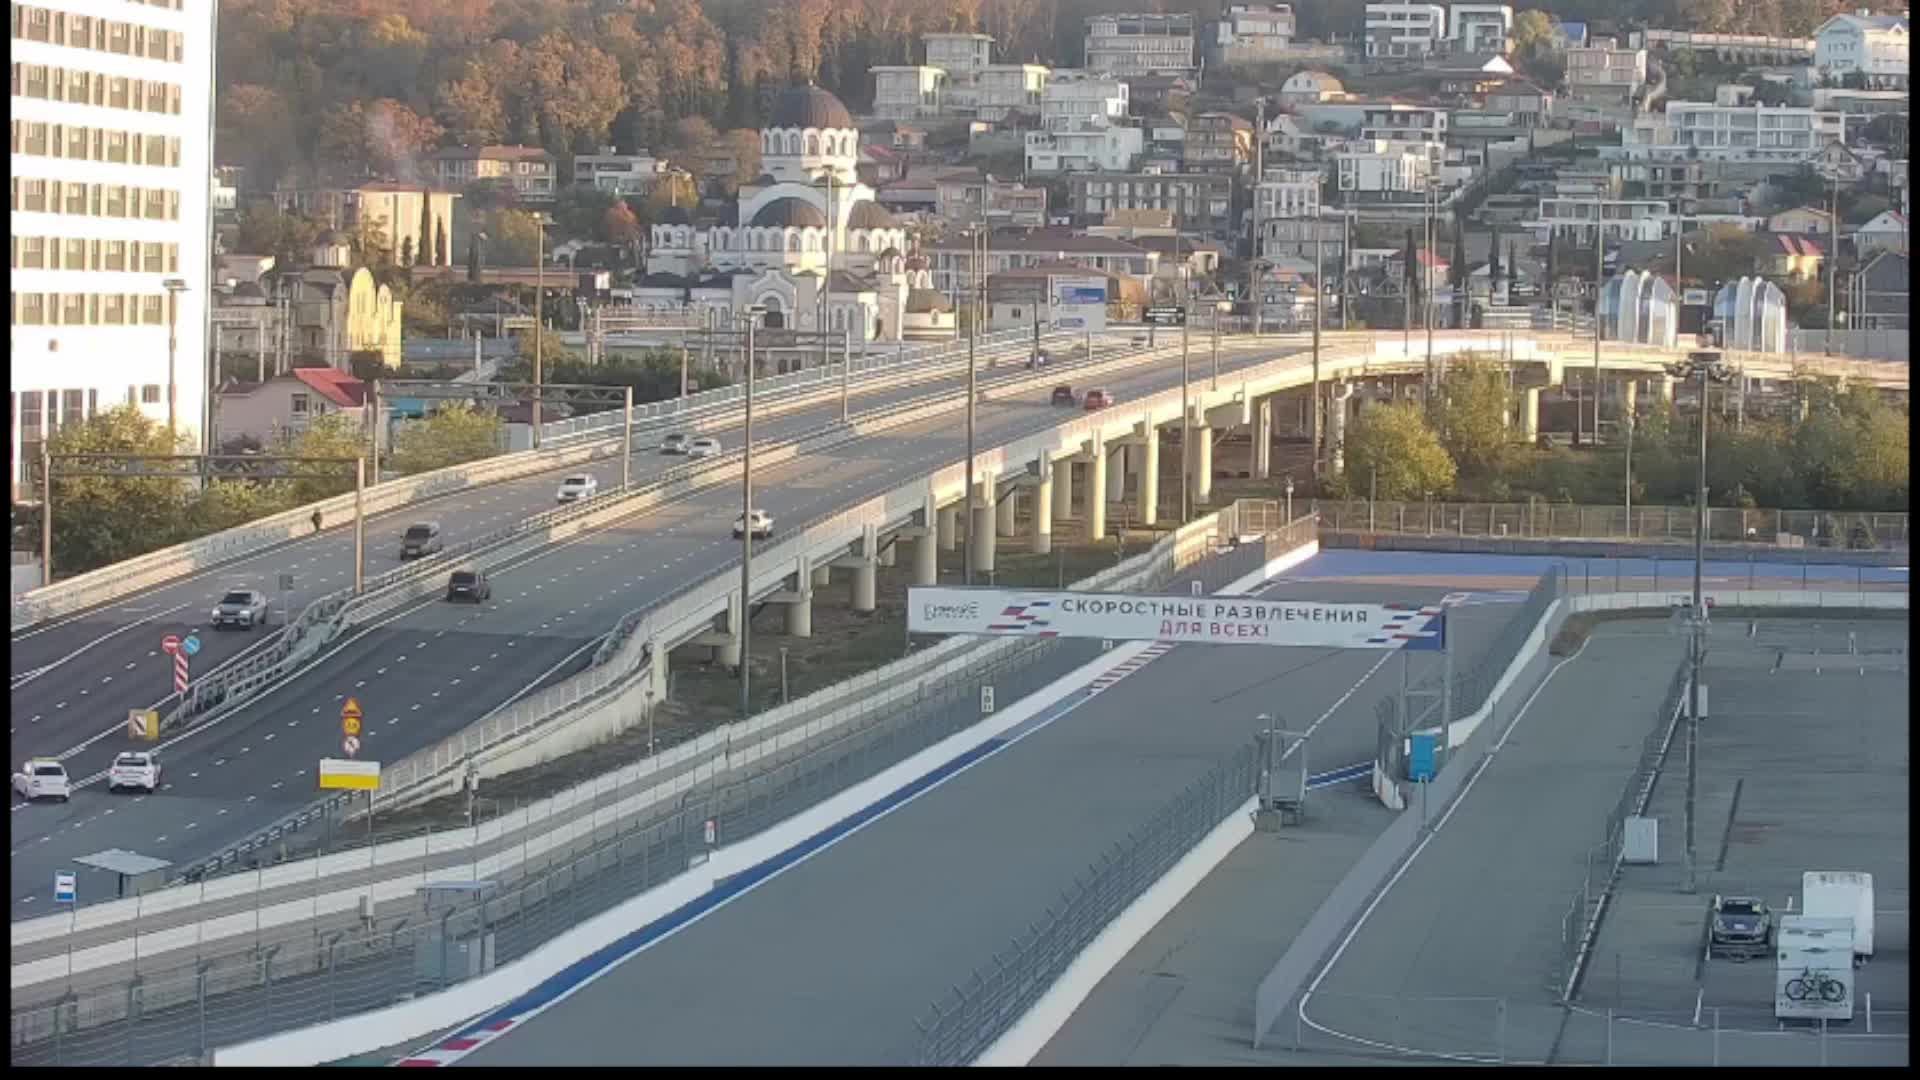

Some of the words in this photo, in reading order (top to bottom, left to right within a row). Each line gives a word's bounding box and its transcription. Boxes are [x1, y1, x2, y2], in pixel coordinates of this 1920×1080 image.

[1062, 600, 1206, 618] СКОРОСТНЫЕ
[1214, 604, 1368, 623] РАЗВЛЕЧЕНИЯ
[1159, 619, 1201, 636] ДЛЯ
[1209, 622, 1269, 638] ВСЕХ!
